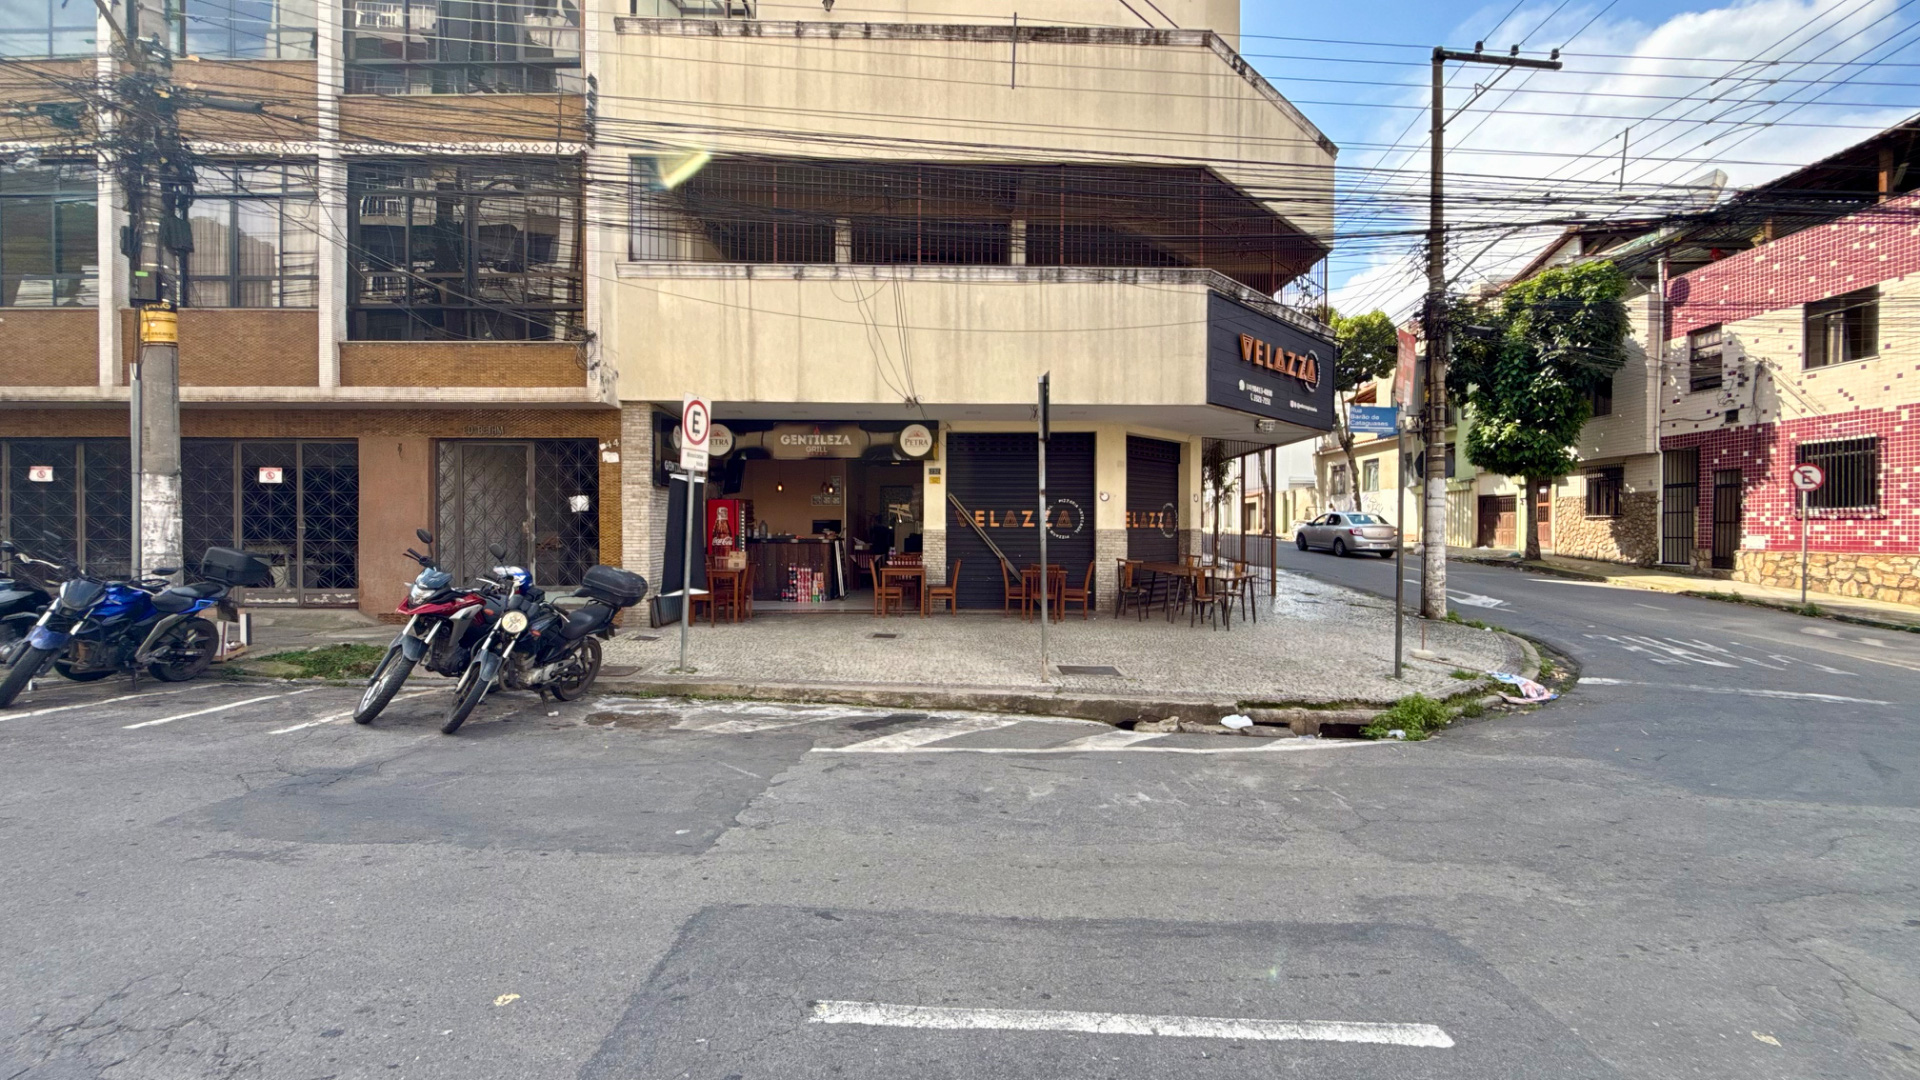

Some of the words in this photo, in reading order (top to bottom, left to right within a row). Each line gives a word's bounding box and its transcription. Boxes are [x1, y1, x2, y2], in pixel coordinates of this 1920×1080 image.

[1239, 332, 1317, 384] VELAZZA
[692, 410, 701, 435] E
[1350, 420, 1389, 428] Cataguases
[709, 438, 729, 446] ETRA
[780, 434, 852, 446] GENTILEZA
[904, 438, 929, 446] PETRA
[805, 445, 828, 453] GRILL
[1801, 469, 1813, 484] E
[1126, 511, 1174, 528] ELAZZA
